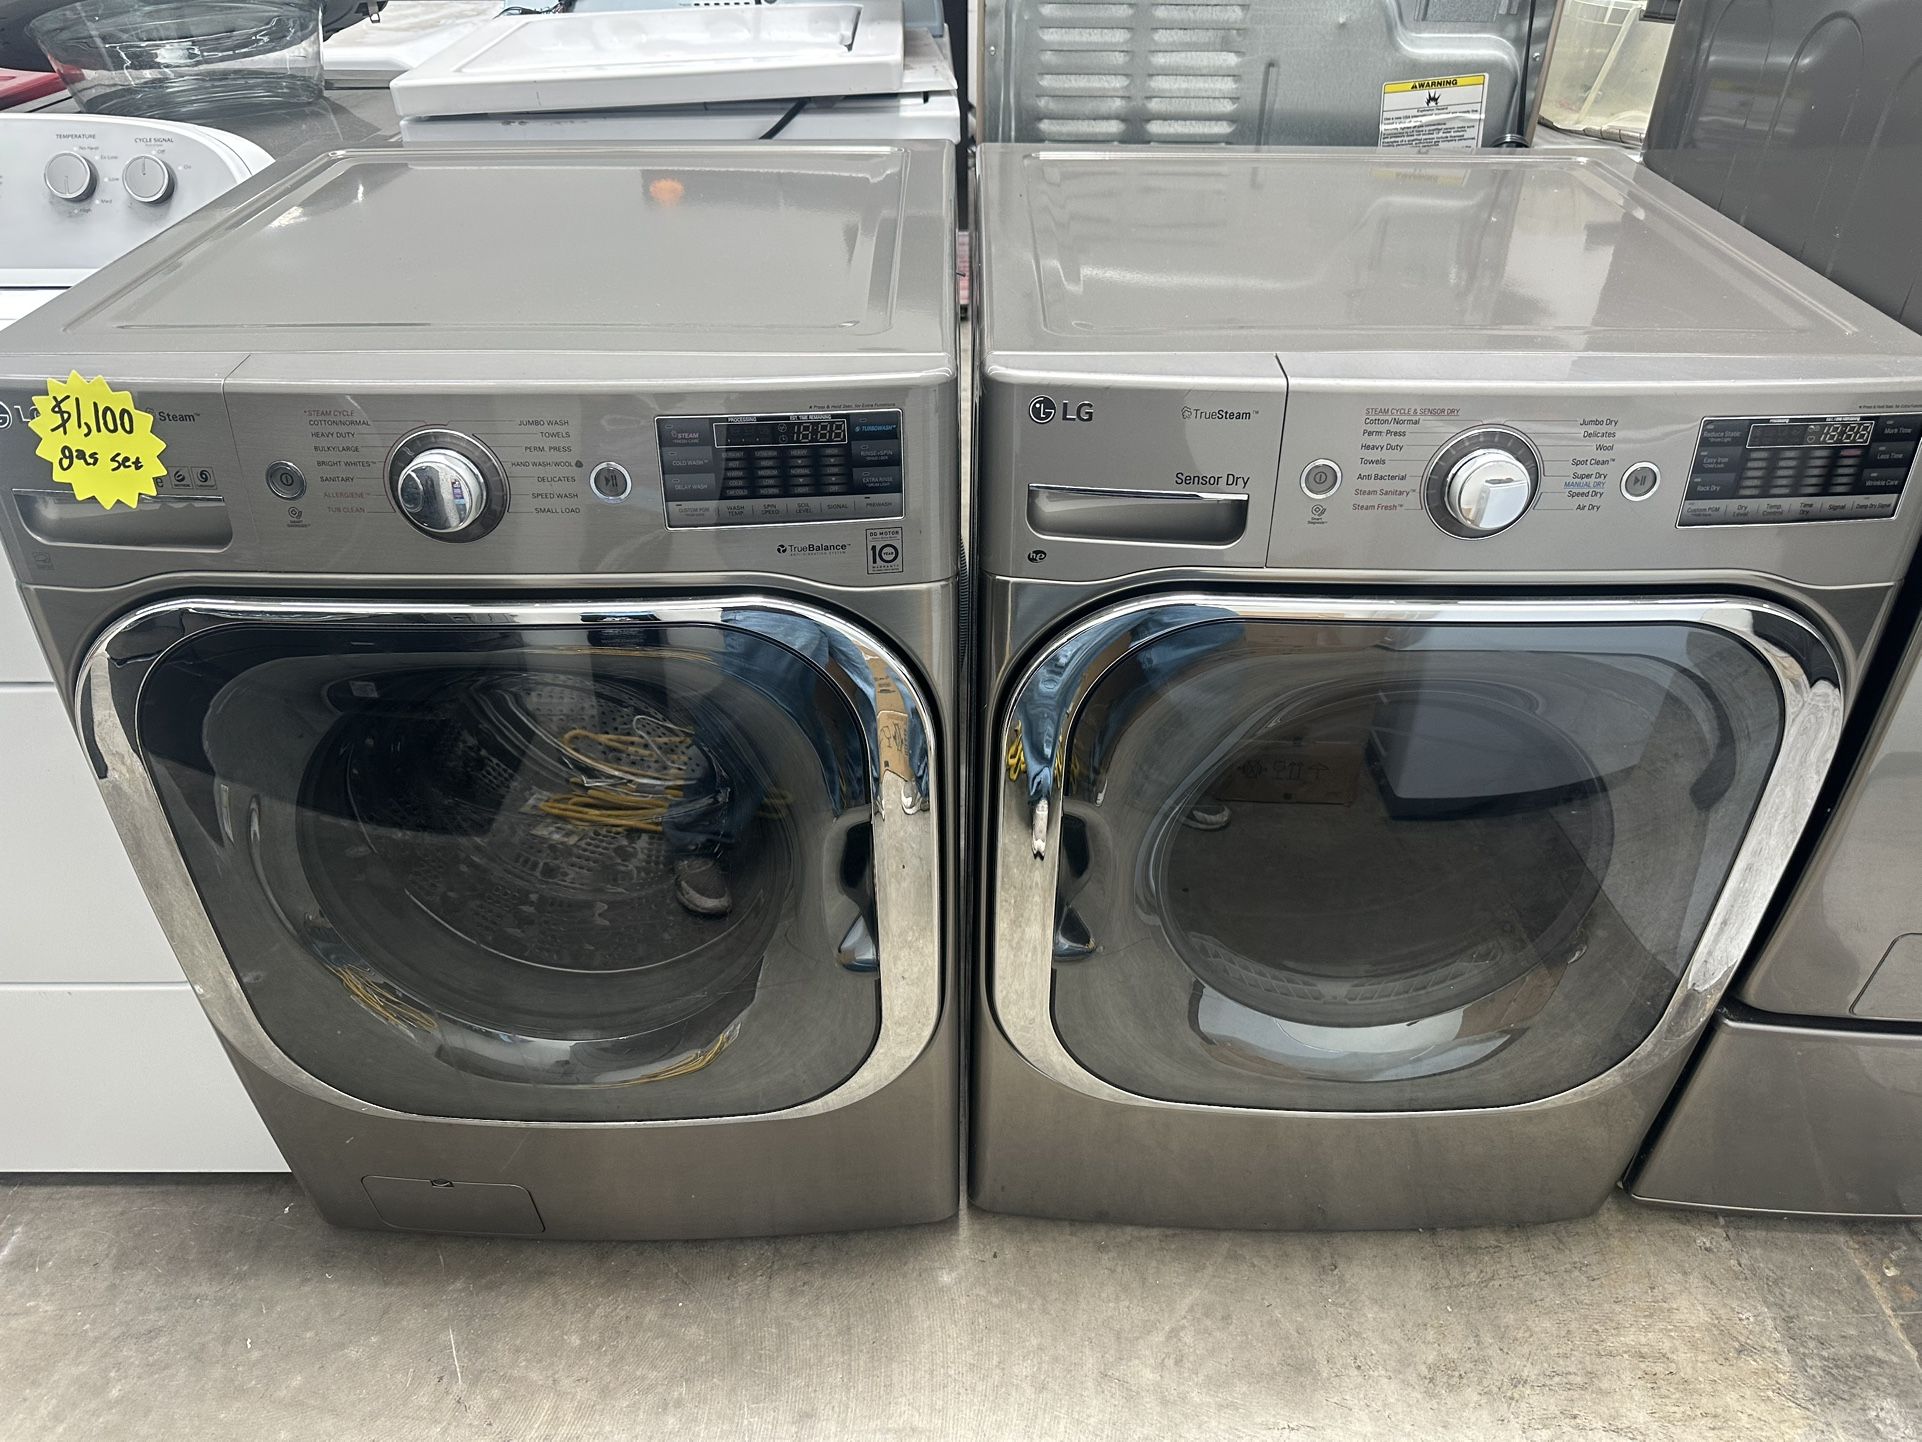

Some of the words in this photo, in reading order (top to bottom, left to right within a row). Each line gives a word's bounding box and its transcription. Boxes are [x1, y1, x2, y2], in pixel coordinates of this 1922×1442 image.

[1418, 79, 1458, 89] WARNING
[1062, 400, 1094, 421] LG
[50, 395, 134, 437] $1,100
[1580, 418, 1604, 426] Jumbo
[1605, 418, 1618, 427] Dry
[1360, 444, 1384, 452] Heavy
[1386, 443, 1404, 452] Duty
[59, 445, 99, 471] gas
[110, 452, 144, 471] set
[1571, 458, 1588, 466] Spot
[1175, 472, 1222, 486] Sensor
[1226, 474, 1250, 489] Dry
[1572, 472, 1594, 480] Super
[1595, 472, 1608, 480] Dry
[1590, 490, 1604, 498] Dry
[1588, 504, 1600, 512] Dry
[871, 544, 899, 564] 10
